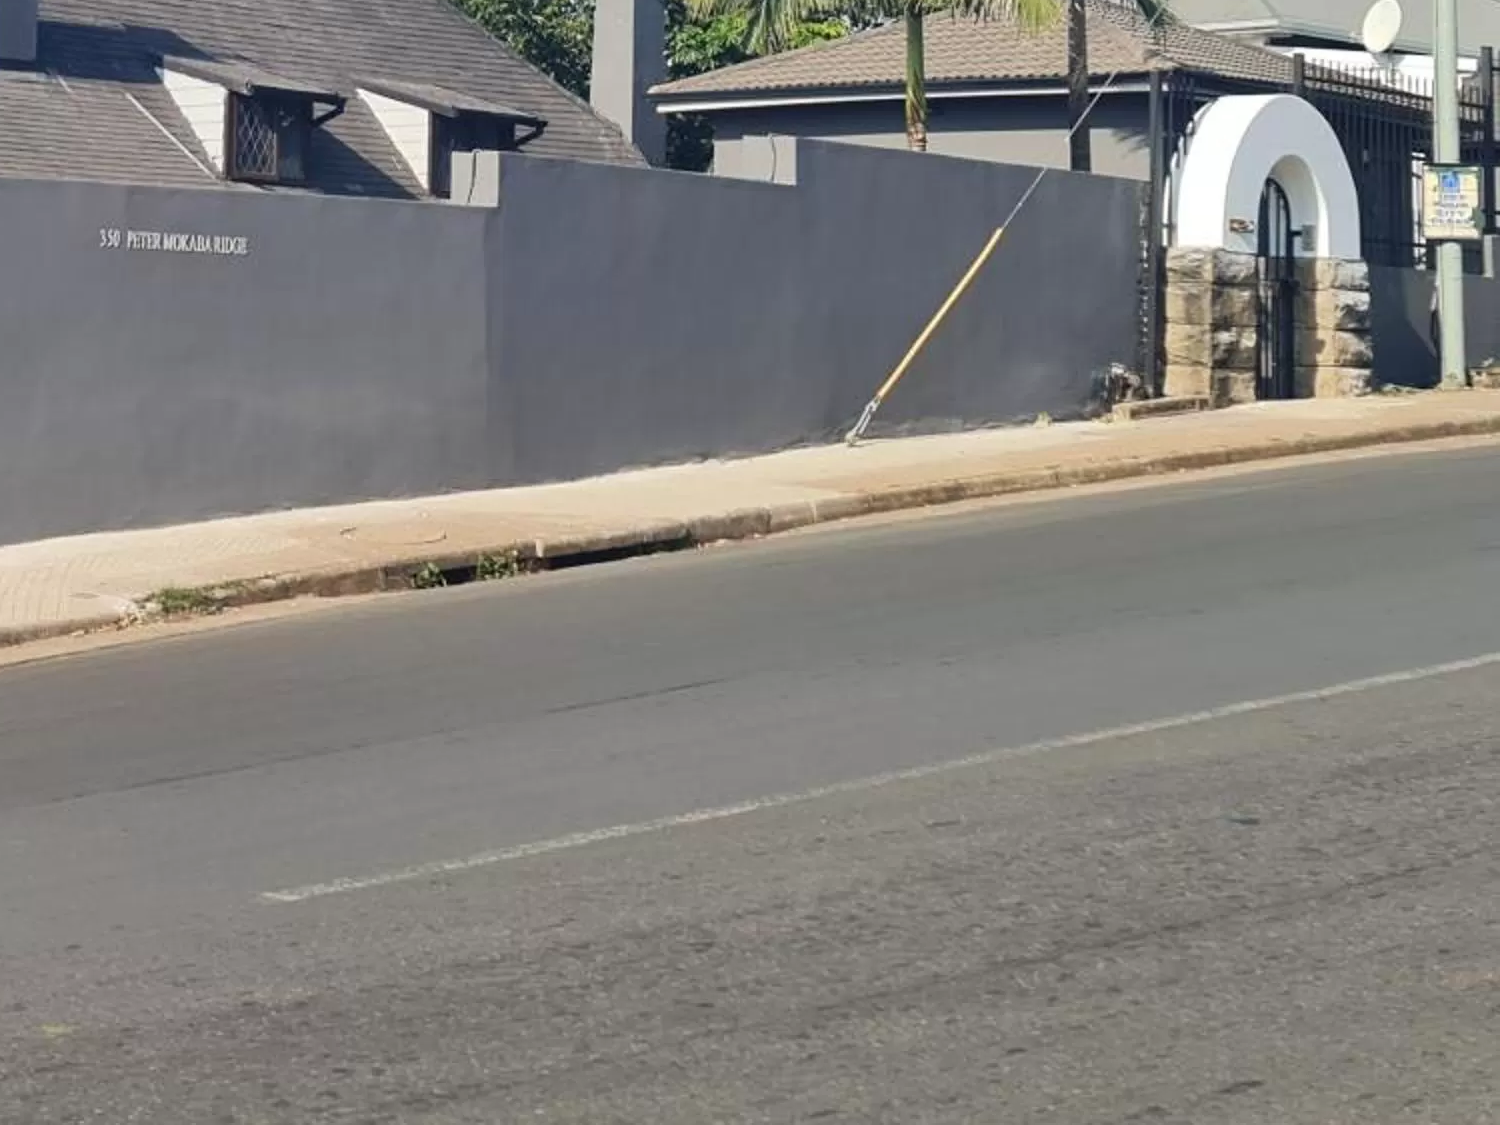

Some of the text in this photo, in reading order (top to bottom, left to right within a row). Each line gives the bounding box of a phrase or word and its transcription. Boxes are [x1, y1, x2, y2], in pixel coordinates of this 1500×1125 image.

[99, 228, 248, 255] 350 PETER MOKABA RIDGE
